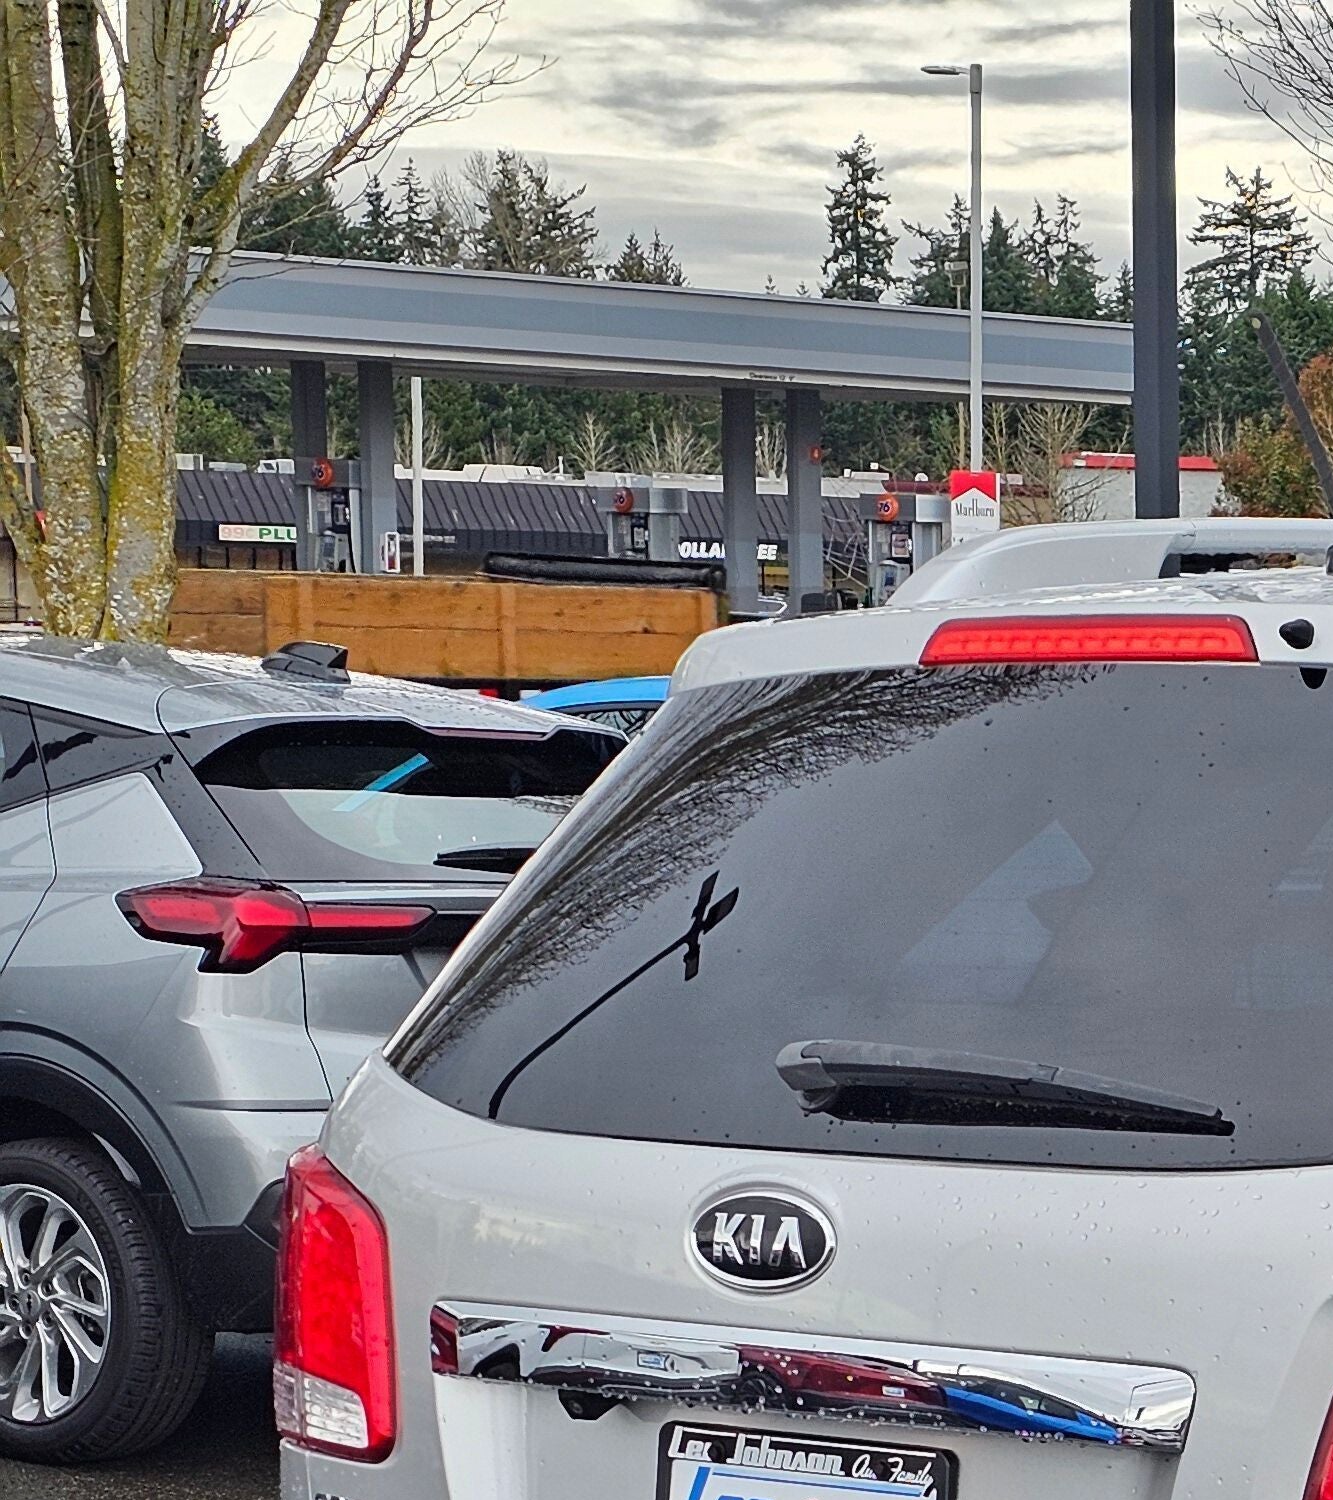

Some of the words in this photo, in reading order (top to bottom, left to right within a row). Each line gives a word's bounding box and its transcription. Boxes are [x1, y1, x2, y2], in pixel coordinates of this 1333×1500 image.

[955, 498, 995, 517] Marlboro
[258, 528, 297, 540] PLU
[678, 541, 725, 559] OLLA
[711, 1210, 808, 1270] KIA
[726, 1433, 846, 1476] Johnson
[888, 1457, 935, 1496] Family
